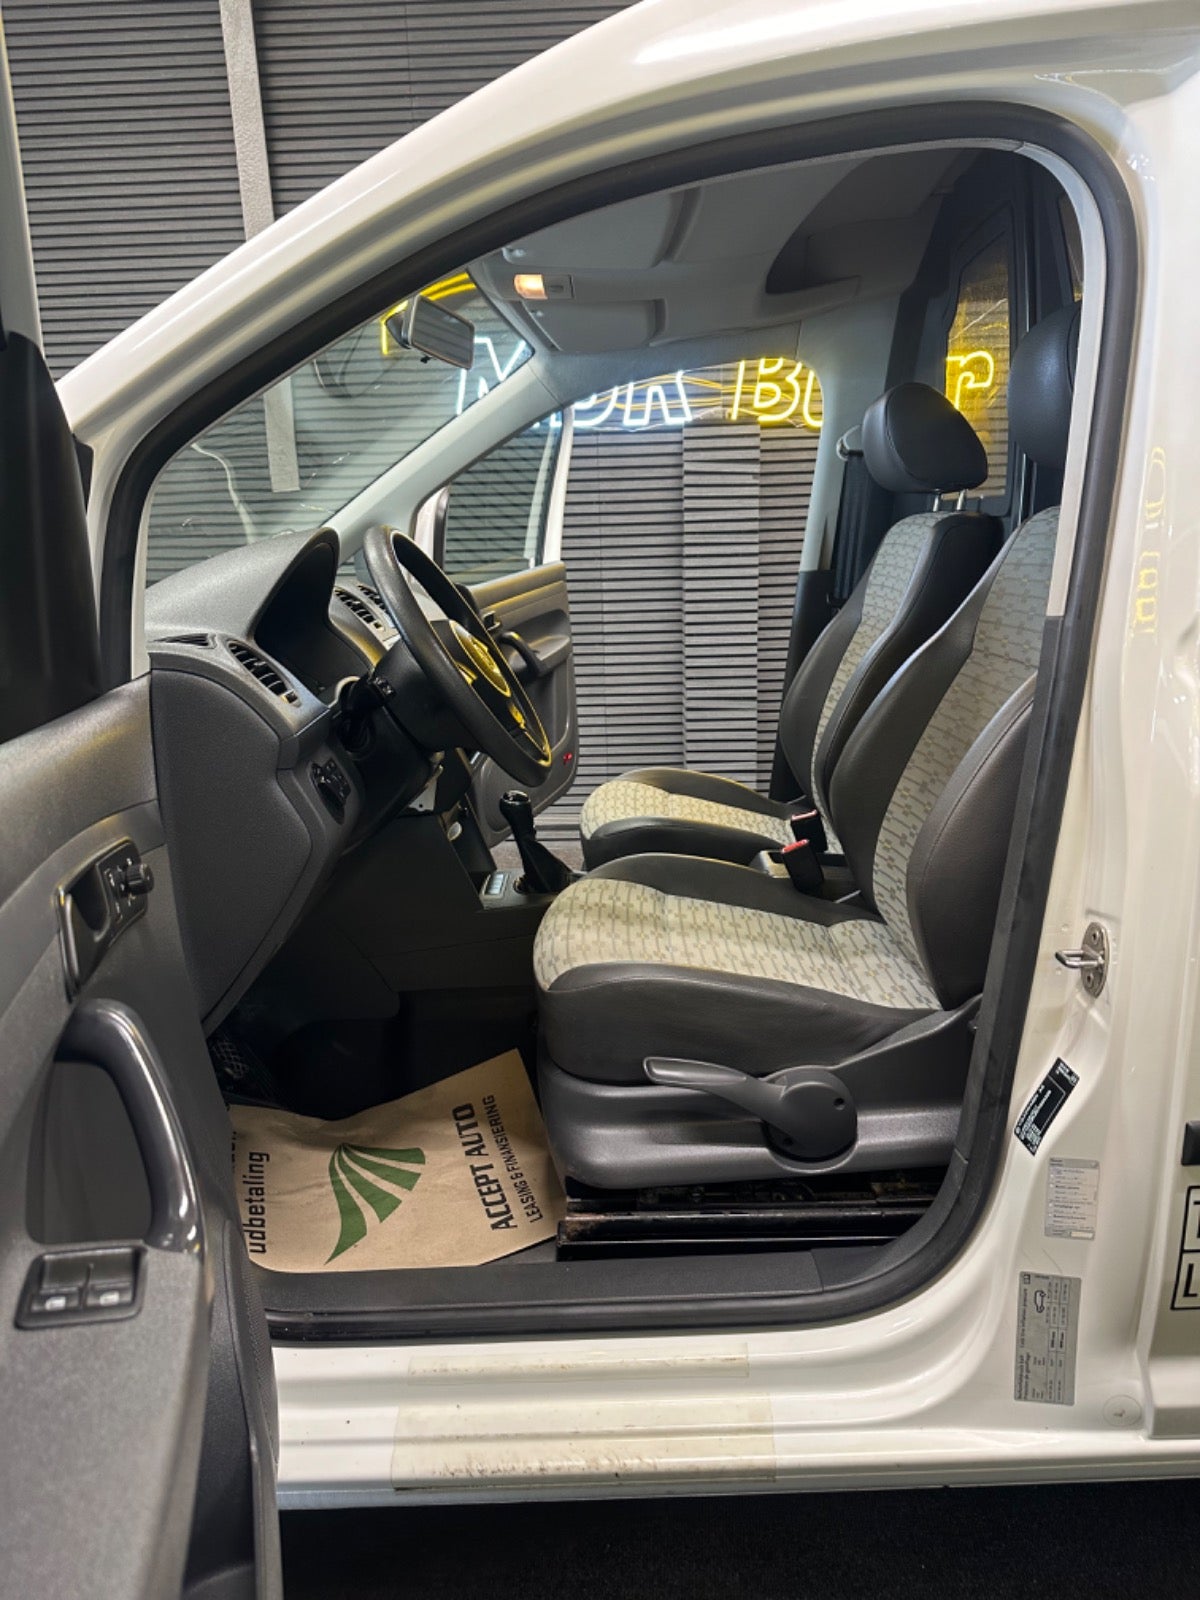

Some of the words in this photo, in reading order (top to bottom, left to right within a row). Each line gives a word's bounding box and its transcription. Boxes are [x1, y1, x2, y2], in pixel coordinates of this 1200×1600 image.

[452, 1102, 488, 1157] AUTO
[482, 1094, 518, 1172] FINANSIERING
[242, 1151, 270, 1254] udbetaling
[470, 1163, 518, 1231] ACCEPT
[513, 1180, 543, 1223] LEASING
